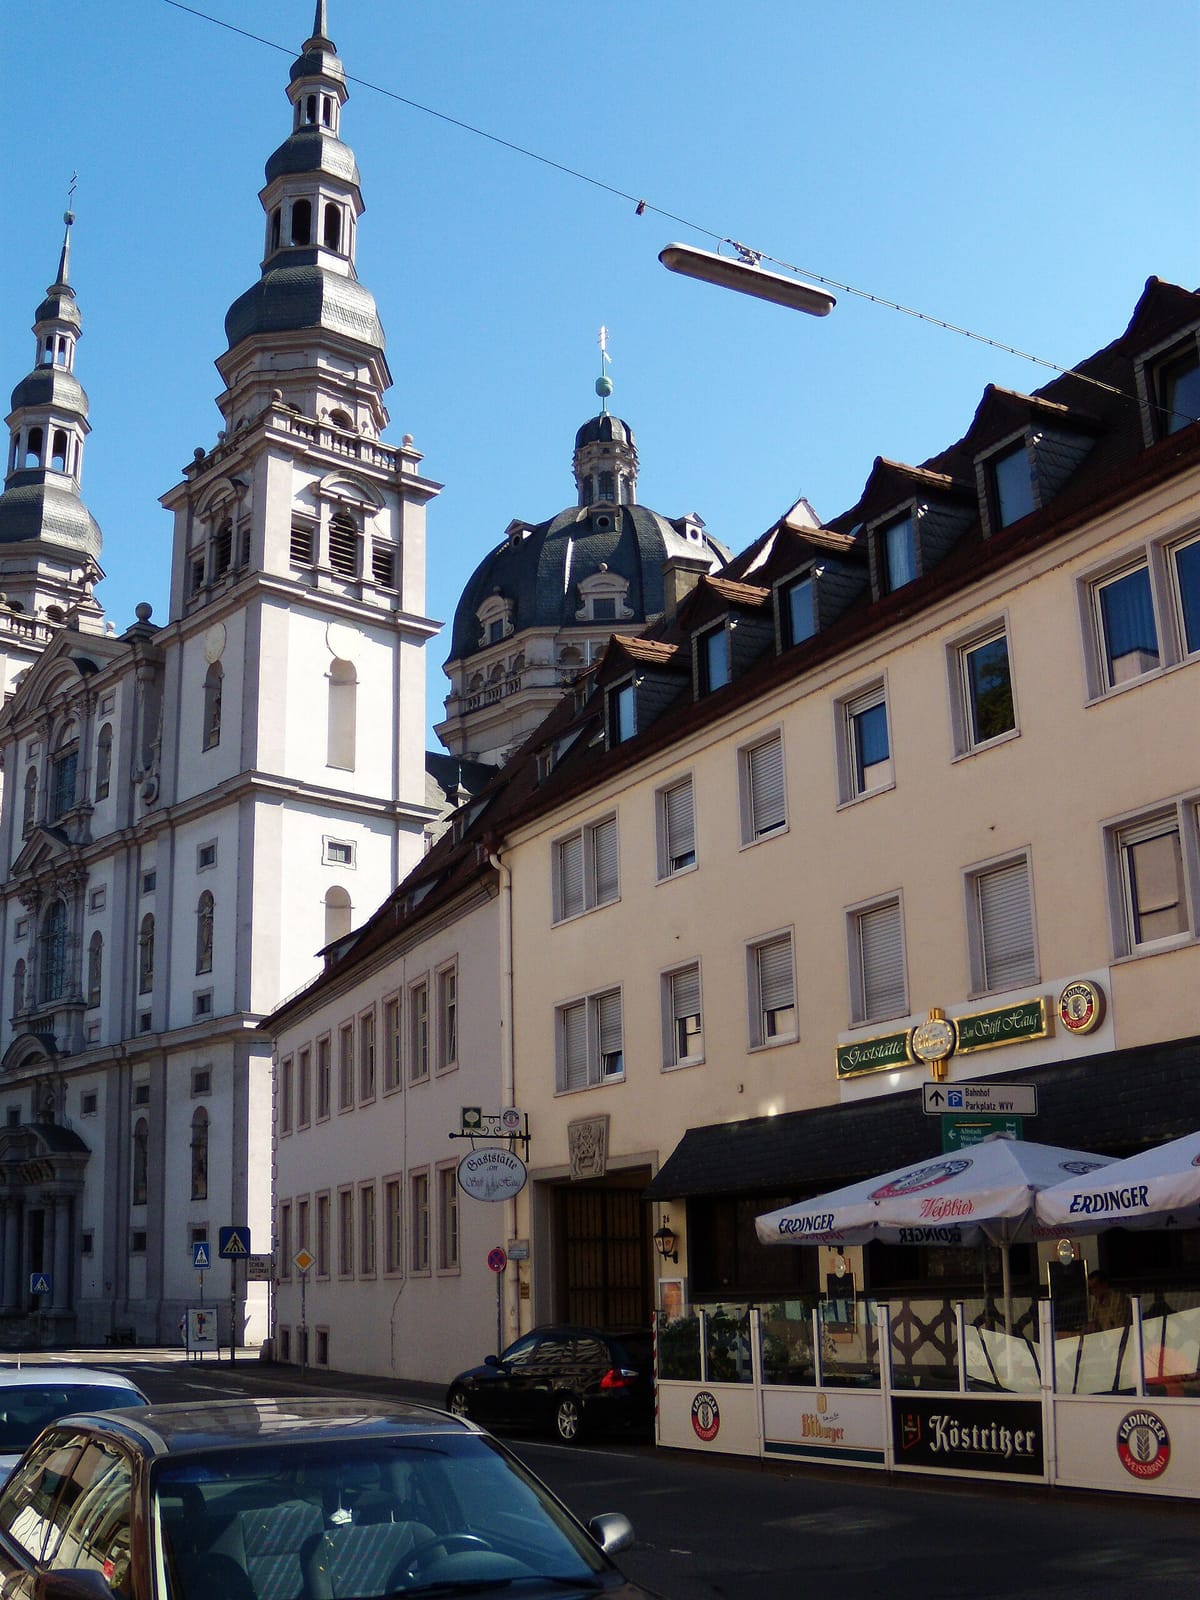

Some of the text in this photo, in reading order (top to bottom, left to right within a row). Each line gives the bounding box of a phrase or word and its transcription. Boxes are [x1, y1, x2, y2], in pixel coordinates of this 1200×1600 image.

[1002, 1009, 1039, 1032] Haug
[840, 1041, 904, 1071] Gaststätte
[965, 1088, 990, 1098] Bahnhof
[965, 1101, 997, 1113] Parkplatz
[467, 1152, 518, 1171] Gaststätte
[919, 1197, 975, 1223] Weißbier
[1069, 1184, 1150, 1214] ERDINGER
[778, 1213, 835, 1235] ERDINGER
[928, 1415, 1036, 1459] Köstritzer
[1119, 1414, 1166, 1441] ERDINGER
